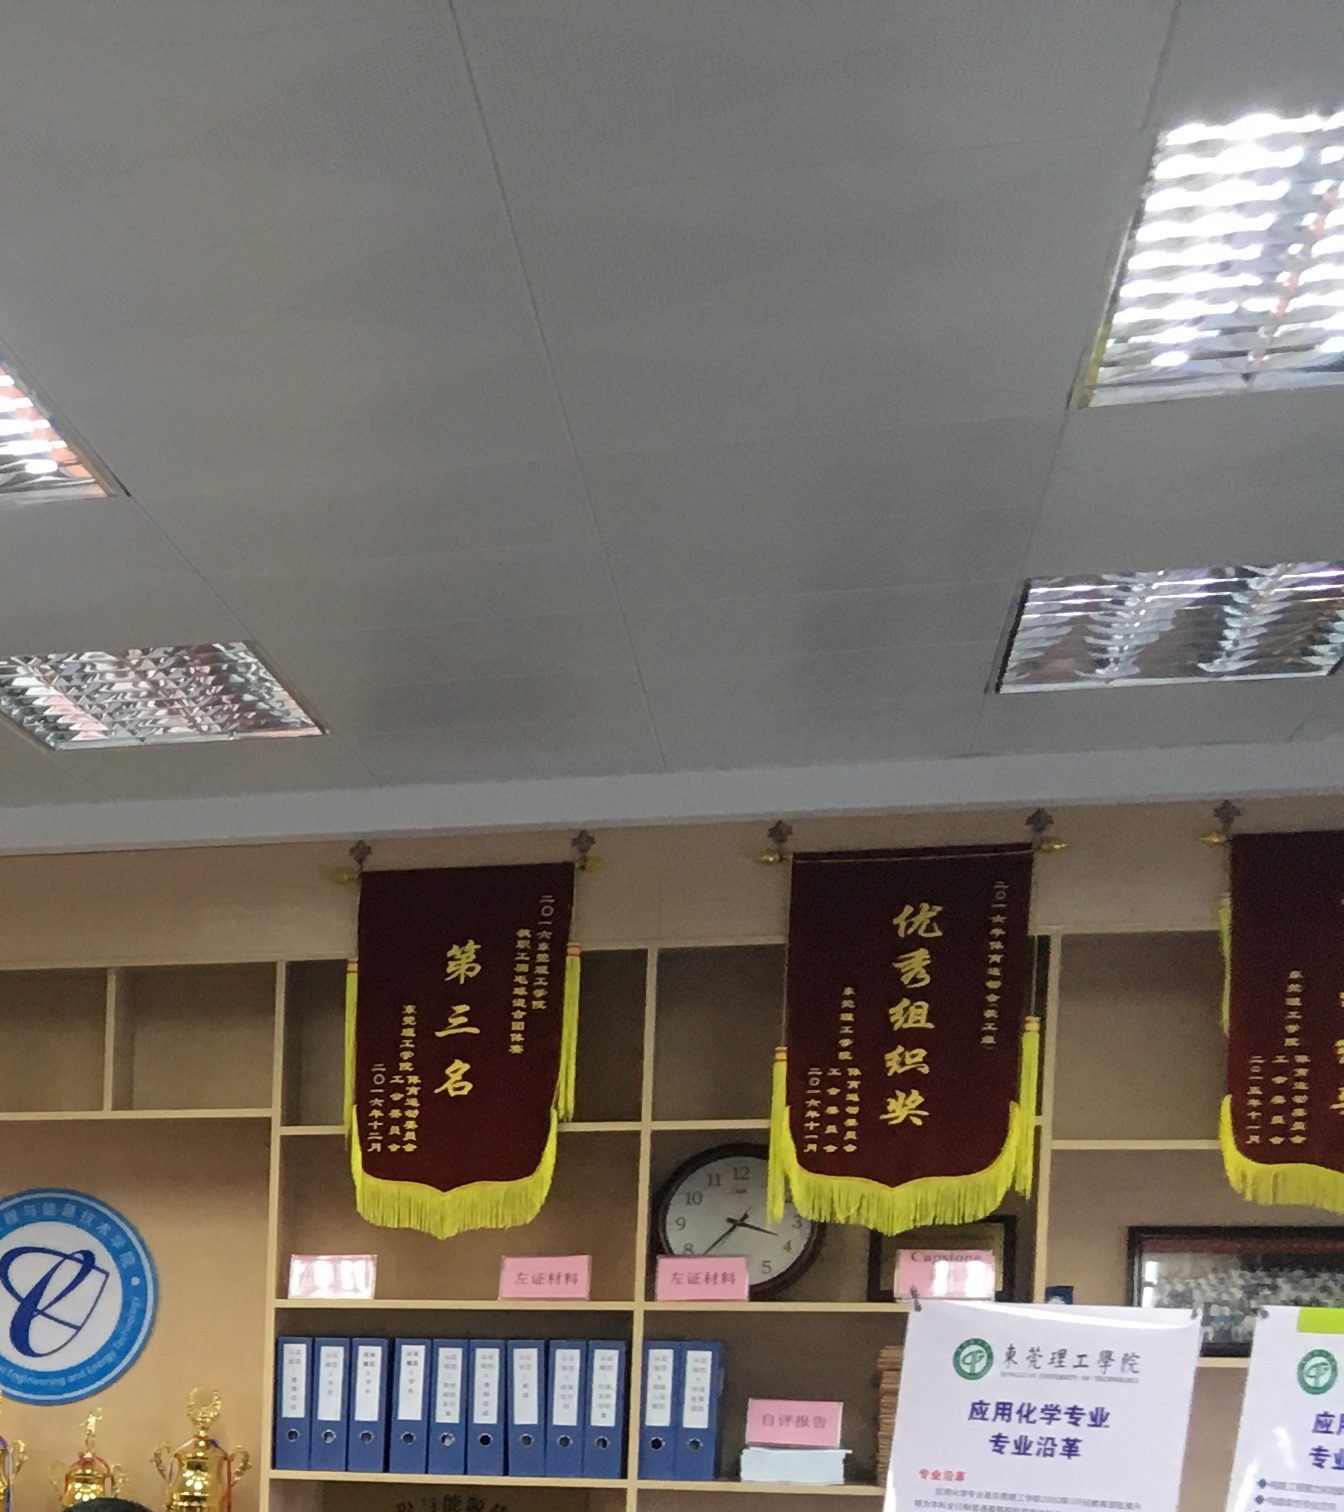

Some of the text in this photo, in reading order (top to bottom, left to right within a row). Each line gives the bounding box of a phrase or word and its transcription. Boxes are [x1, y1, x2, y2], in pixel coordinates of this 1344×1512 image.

[434, 940, 482, 1097] 第三名
[879, 902, 943, 1126] 优秀组织奖
[399, 1005, 417, 1071] 东莞理工学院
[707, 1173, 722, 1187] 11
[733, 1166, 750, 1181] 12
[685, 1191, 703, 1206] 10
[675, 1217, 686, 1231] 9
[791, 1215, 803, 1229] 3
[783, 1240, 793, 1253] 4
[762, 1260, 772, 1274] 5
[514, 1270, 580, 1287] 左证材料
[671, 1271, 737, 1286] 左证材料
[761, 1412, 828, 1430] 自评报告
[968, 1399, 1111, 1429] 应用化学专业
[988, 1432, 1083, 1460] 专业沿革
